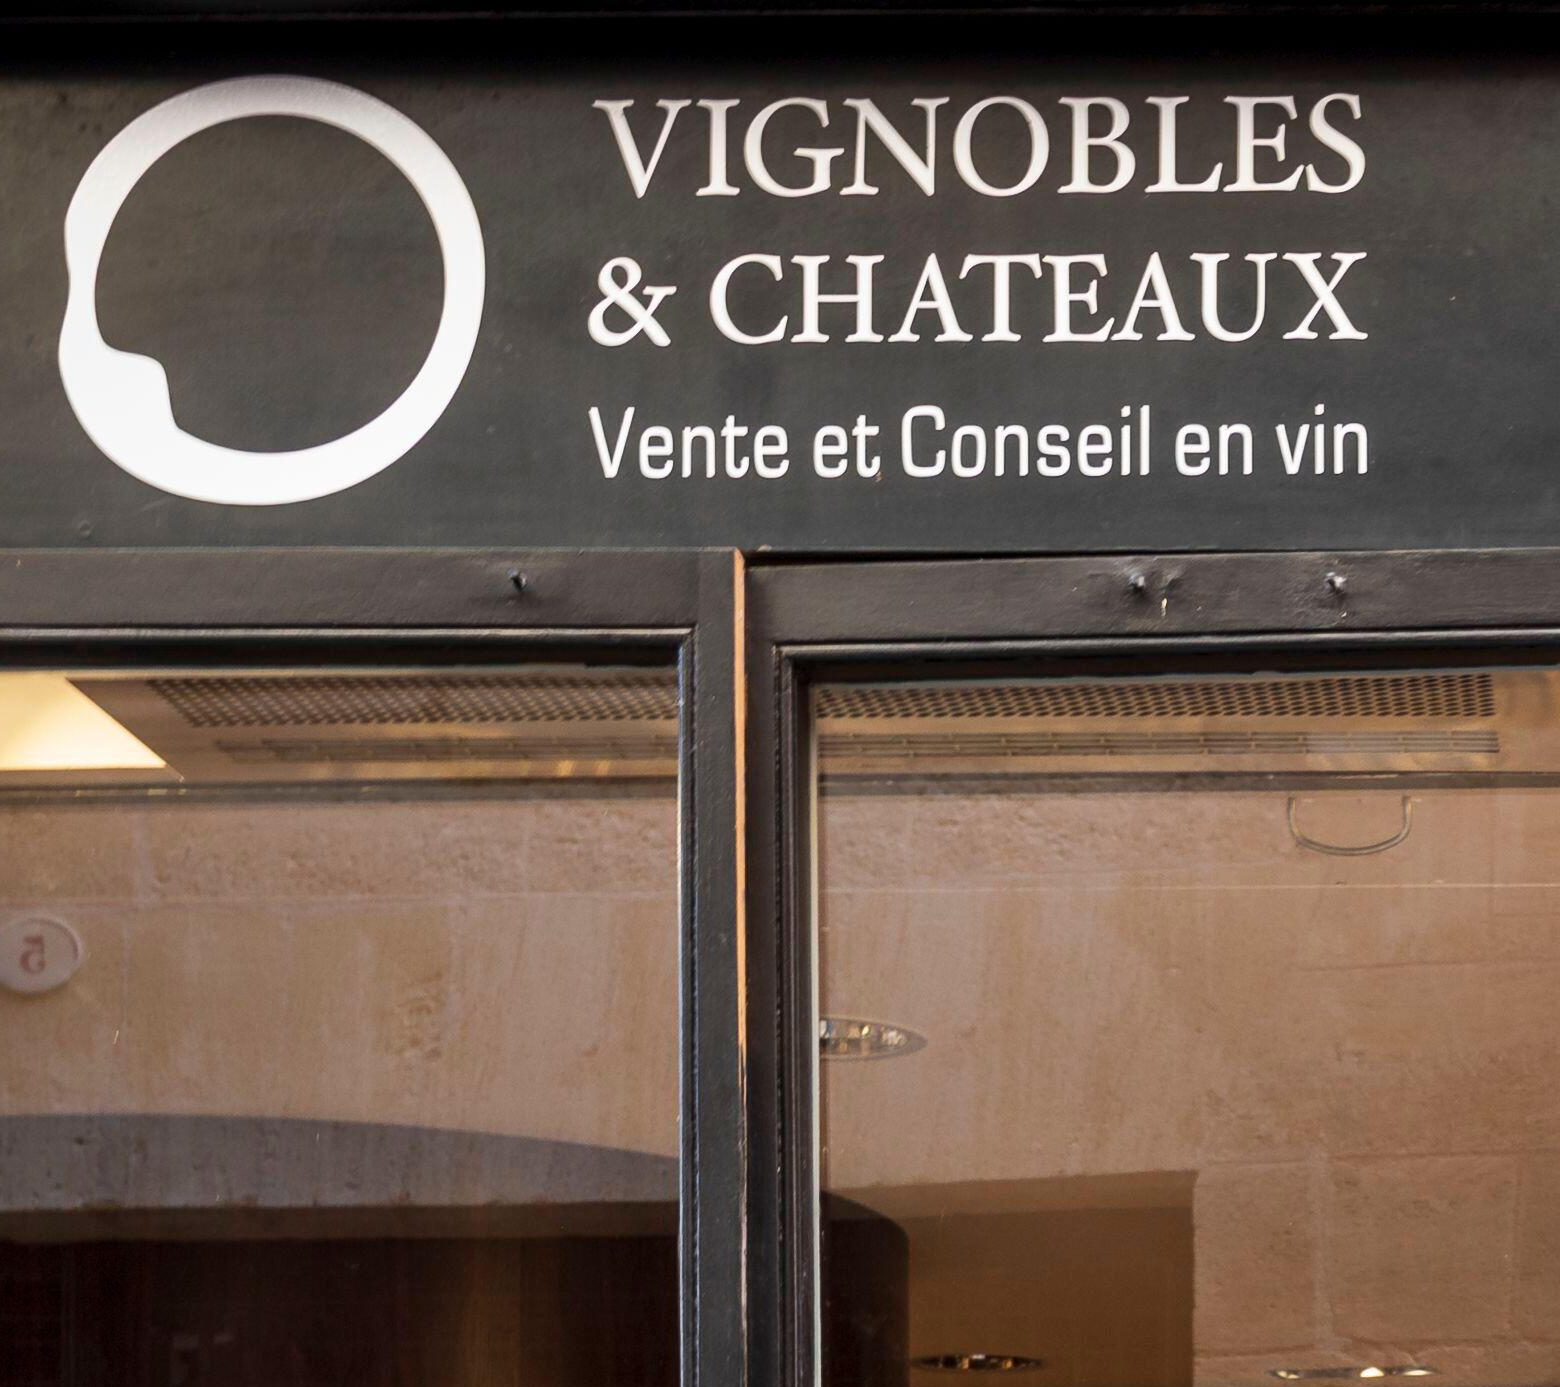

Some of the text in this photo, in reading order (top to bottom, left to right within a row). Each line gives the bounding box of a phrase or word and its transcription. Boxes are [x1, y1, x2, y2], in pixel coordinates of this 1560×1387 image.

[592, 92, 1366, 199] VIGNOBLES
[587, 251, 1369, 347] & CHATEAUX
[587, 403, 1368, 480] Vente et Conseil en vin
